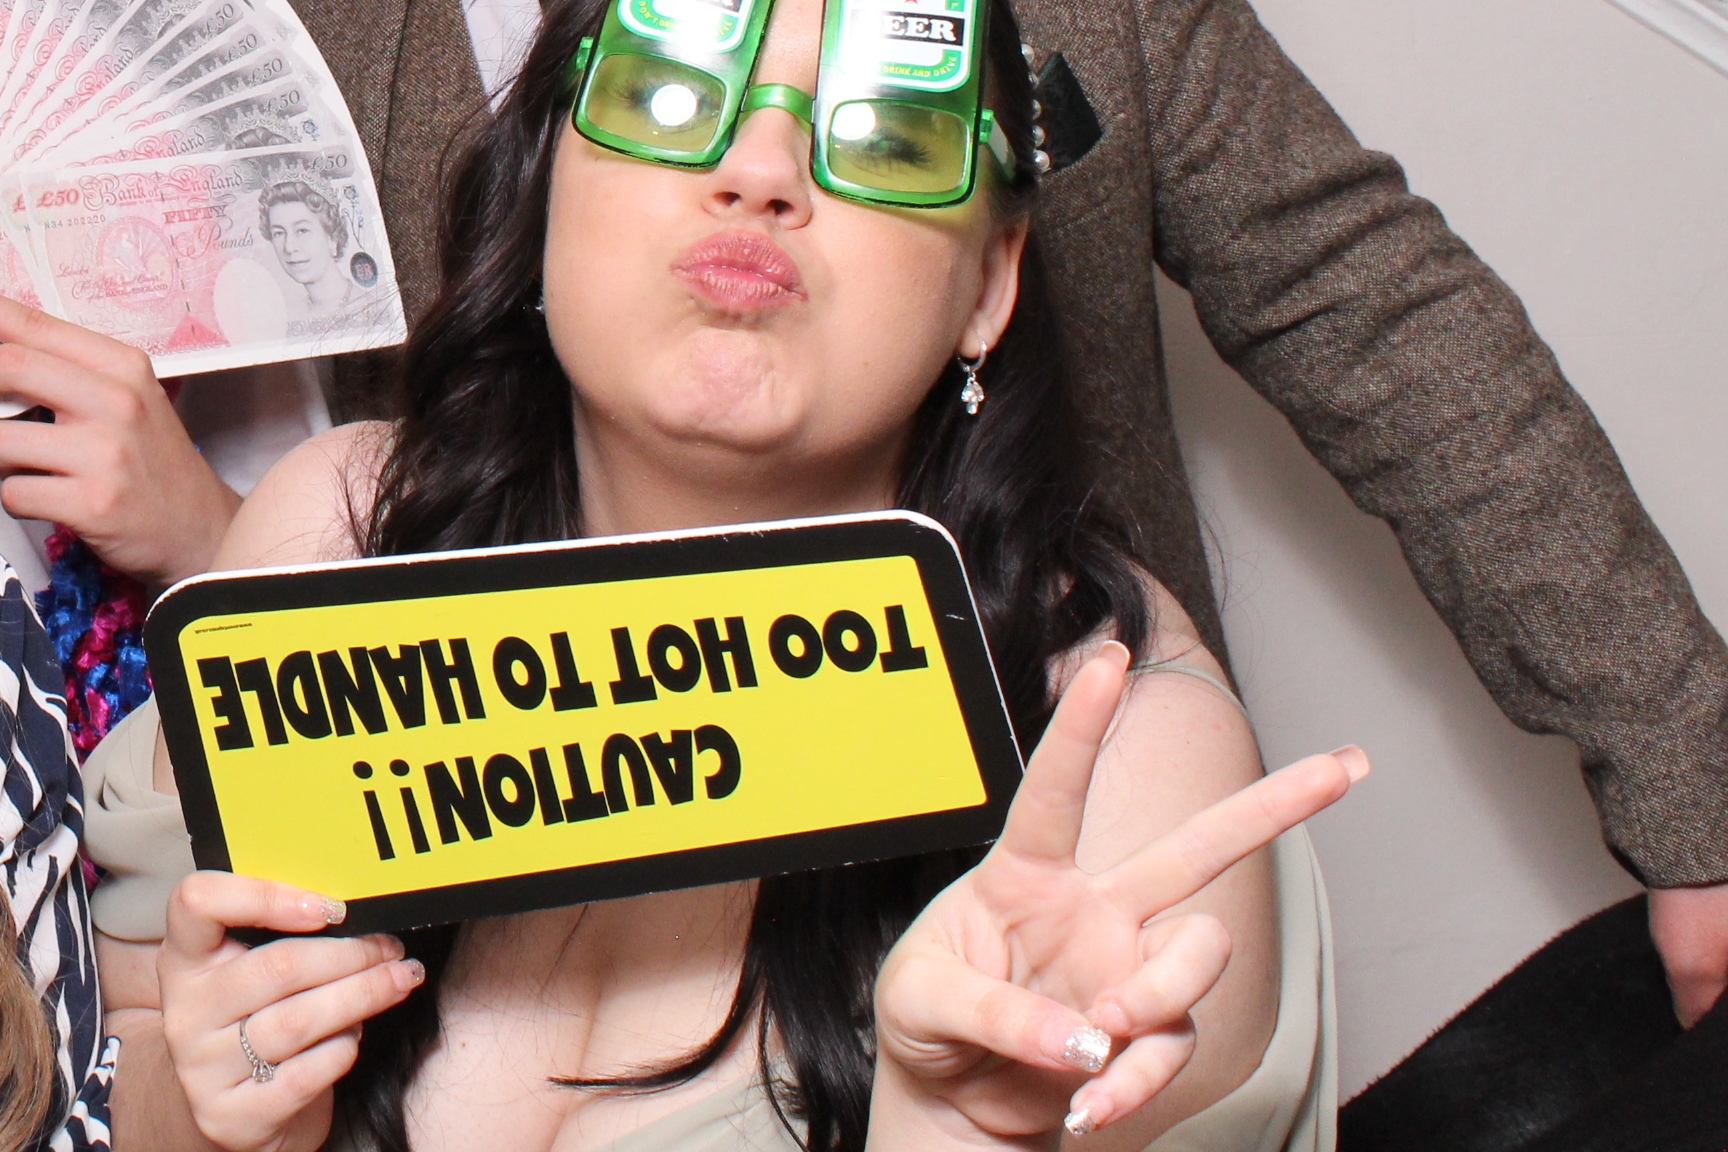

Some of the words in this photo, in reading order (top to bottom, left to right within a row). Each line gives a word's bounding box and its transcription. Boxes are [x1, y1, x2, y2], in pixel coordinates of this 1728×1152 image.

[204, 3, 235, 35] £50
[880, 15, 957, 42] EER
[225, 33, 258, 63] £50
[249, 58, 283, 85] £50
[883, 65, 911, 76] DRINK
[912, 68, 931, 78] AND
[933, 55, 958, 77] DRIVE
[265, 89, 300, 114] £50
[309, 153, 348, 171] £50
[35, 187, 80, 209] £50
[79, 172, 146, 211] Bank
[148, 188, 160, 198] of
[161, 164, 245, 198] England
[43, 219, 64, 229] N34
[67, 214, 106, 227] 202220
[162, 204, 228, 225] FIFTY
[175, 218, 255, 259] Pounds
[770, 606, 929, 679] TOO
[493, 631, 598, 712] TO
[610, 617, 758, 705] HOT
[197, 637, 486, 752] HANDLE
[354, 725, 741, 861] CAUTION!!
